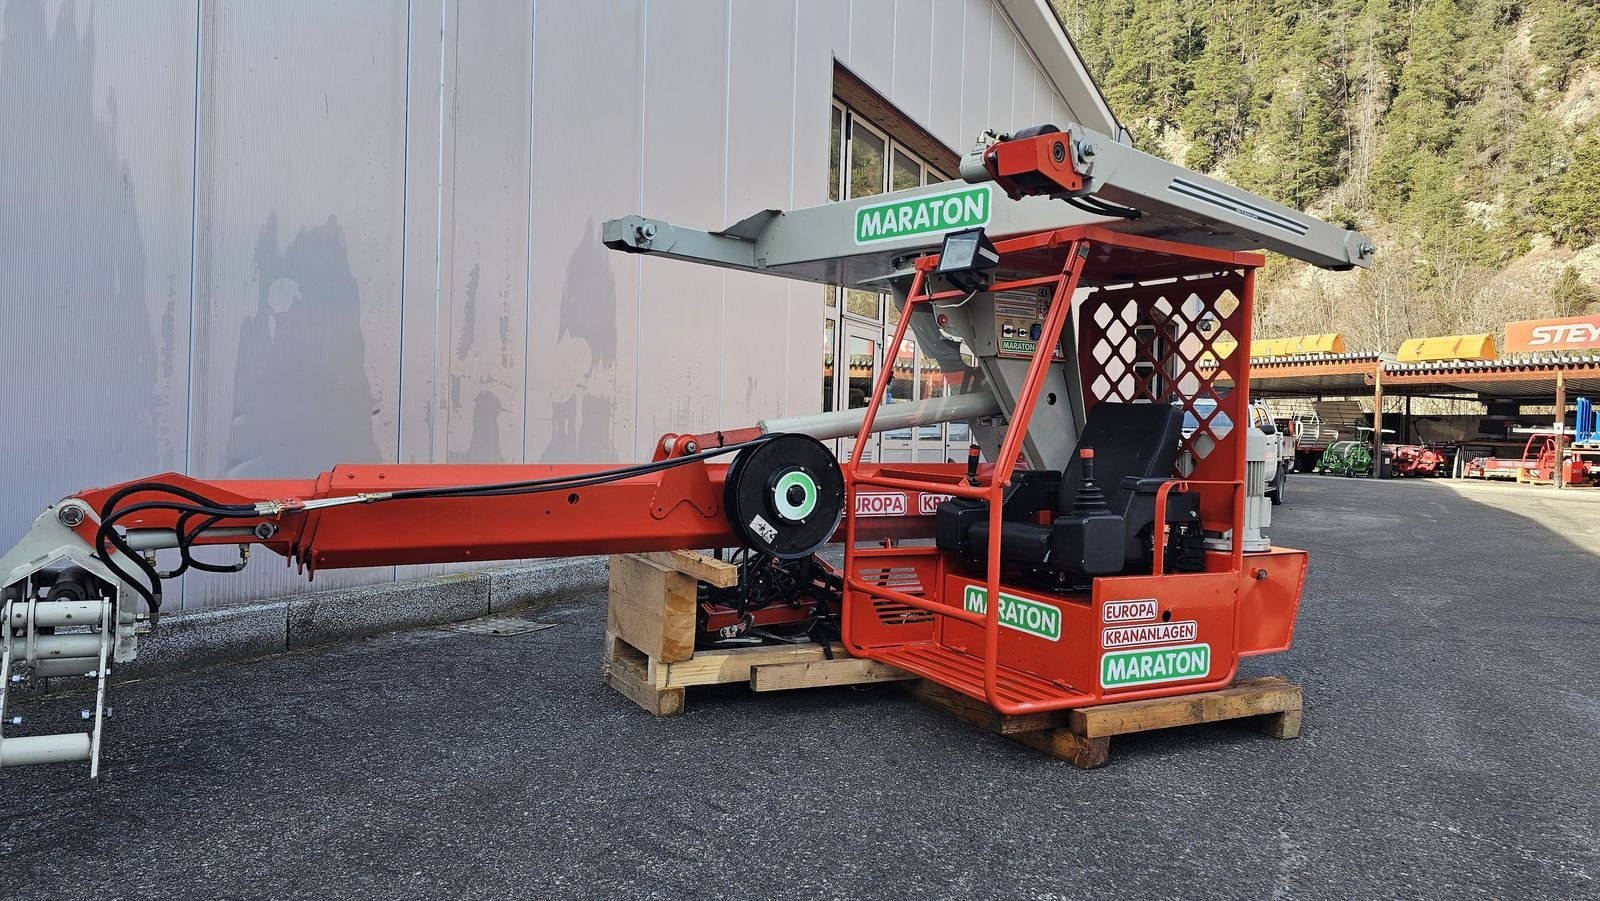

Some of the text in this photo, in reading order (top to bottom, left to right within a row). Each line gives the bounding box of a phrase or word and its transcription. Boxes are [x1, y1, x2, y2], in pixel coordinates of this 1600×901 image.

[861, 192, 984, 238] MARATON
[1002, 341, 1035, 351] MARATON
[968, 591, 1056, 634] MRATON
[1106, 603, 1154, 619] EUROPA
[1105, 625, 1193, 644] KRANANLAGEN
[1107, 650, 1205, 681] MARATON
